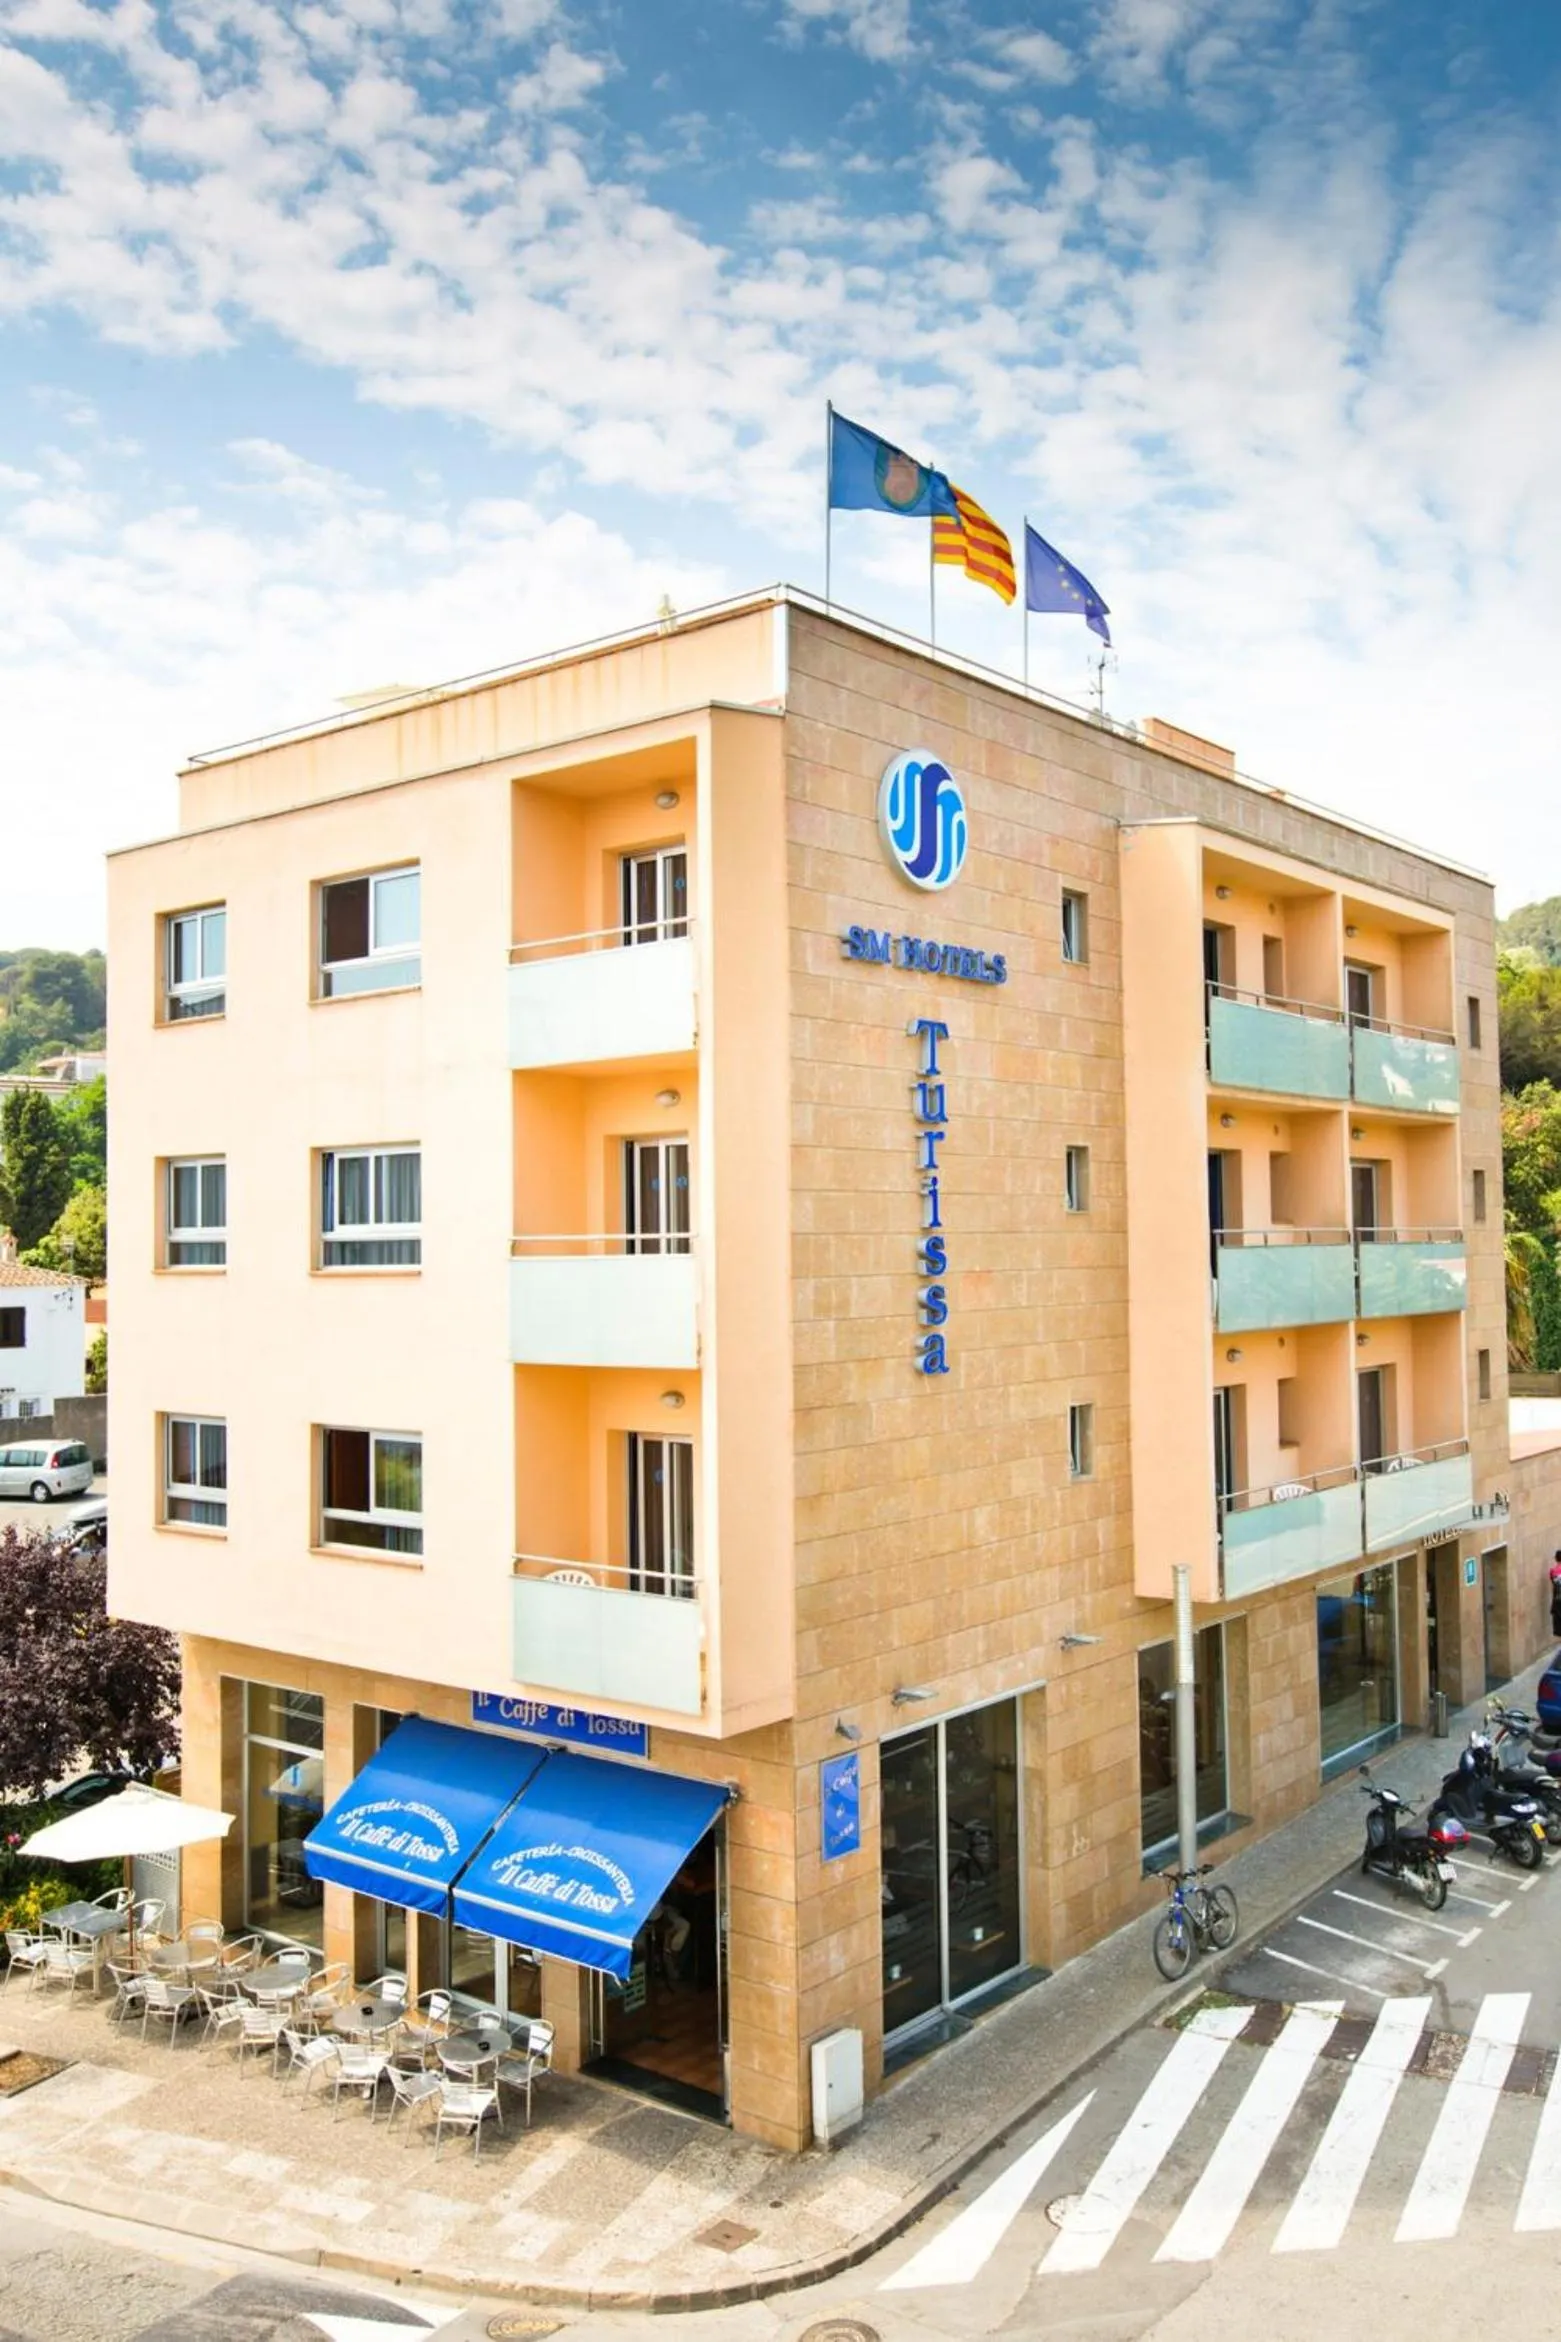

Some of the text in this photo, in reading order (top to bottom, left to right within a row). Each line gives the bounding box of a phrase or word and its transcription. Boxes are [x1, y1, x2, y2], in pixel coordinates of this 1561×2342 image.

[847, 925, 1008, 985] SM HOTELS
[908, 1018, 949, 1375] Turissa
[557, 1708, 575, 1728] di
[339, 1818, 363, 1837] Il
[387, 1831, 411, 1853] di
[402, 1835, 445, 1862] Tossa
[497, 1864, 522, 1886] Il
[553, 1878, 580, 1902] di
[571, 1884, 619, 1914] Tossa
